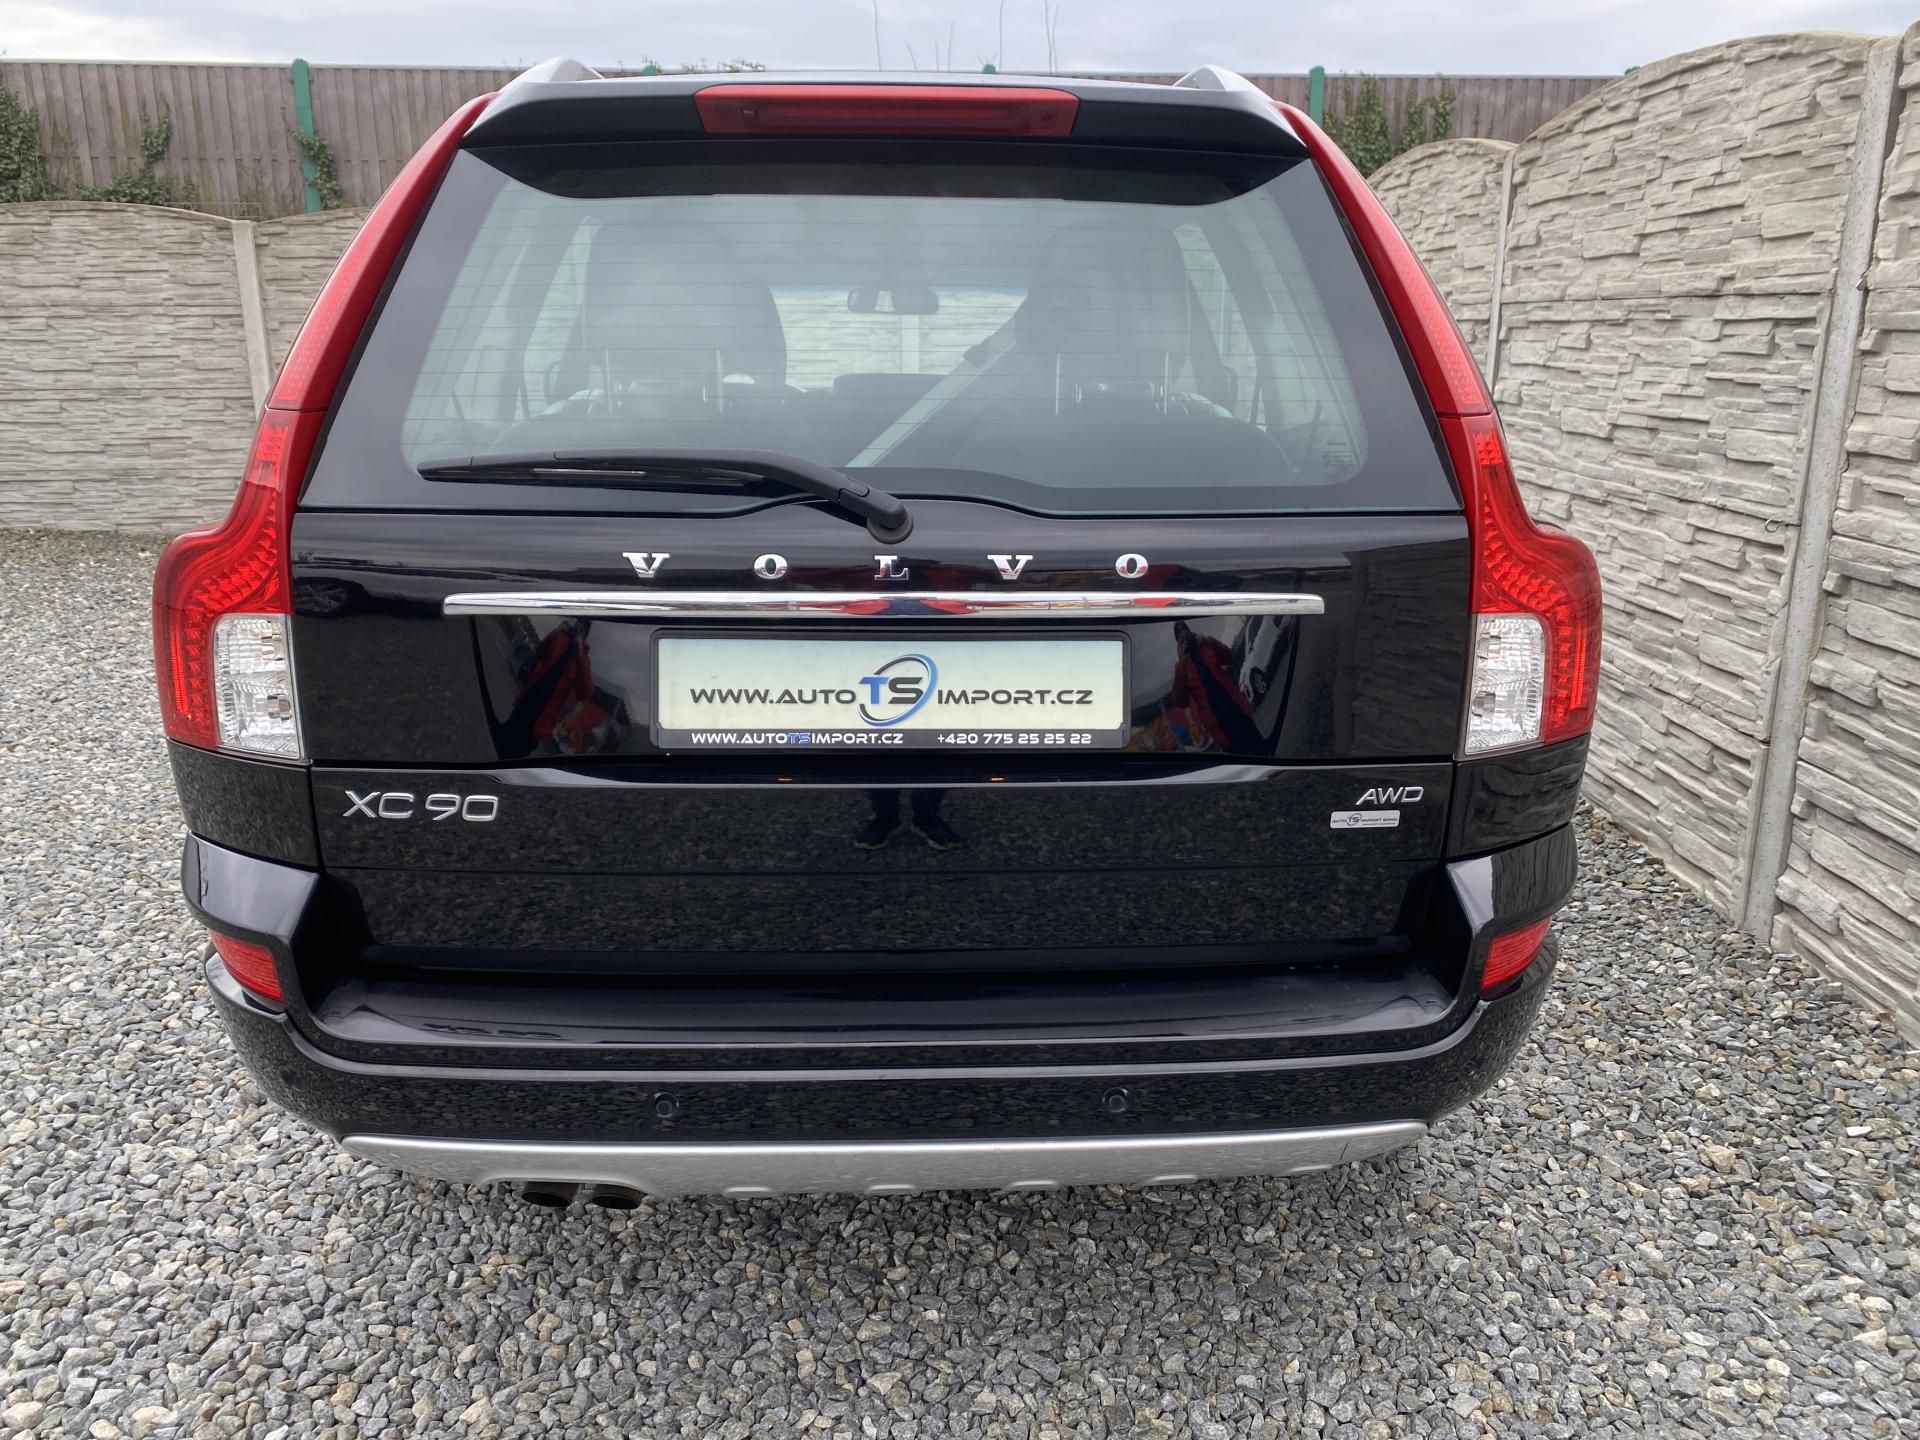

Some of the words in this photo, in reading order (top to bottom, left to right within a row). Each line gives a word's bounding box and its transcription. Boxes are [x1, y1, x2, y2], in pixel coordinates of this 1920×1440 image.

[623, 552, 1149, 580] VOLVO
[691, 732, 903, 744] WWW.AUTOTSIMPORT.CZ
[937, 733, 978, 744] +420
[983, 733, 1013, 744] 775
[1018, 733, 1039, 744] 25
[1044, 733, 1066, 744] 25
[1070, 733, 1092, 744] 22
[342, 790, 414, 819] XC
[425, 793, 498, 822] 90
[1355, 786, 1424, 805] AWD
